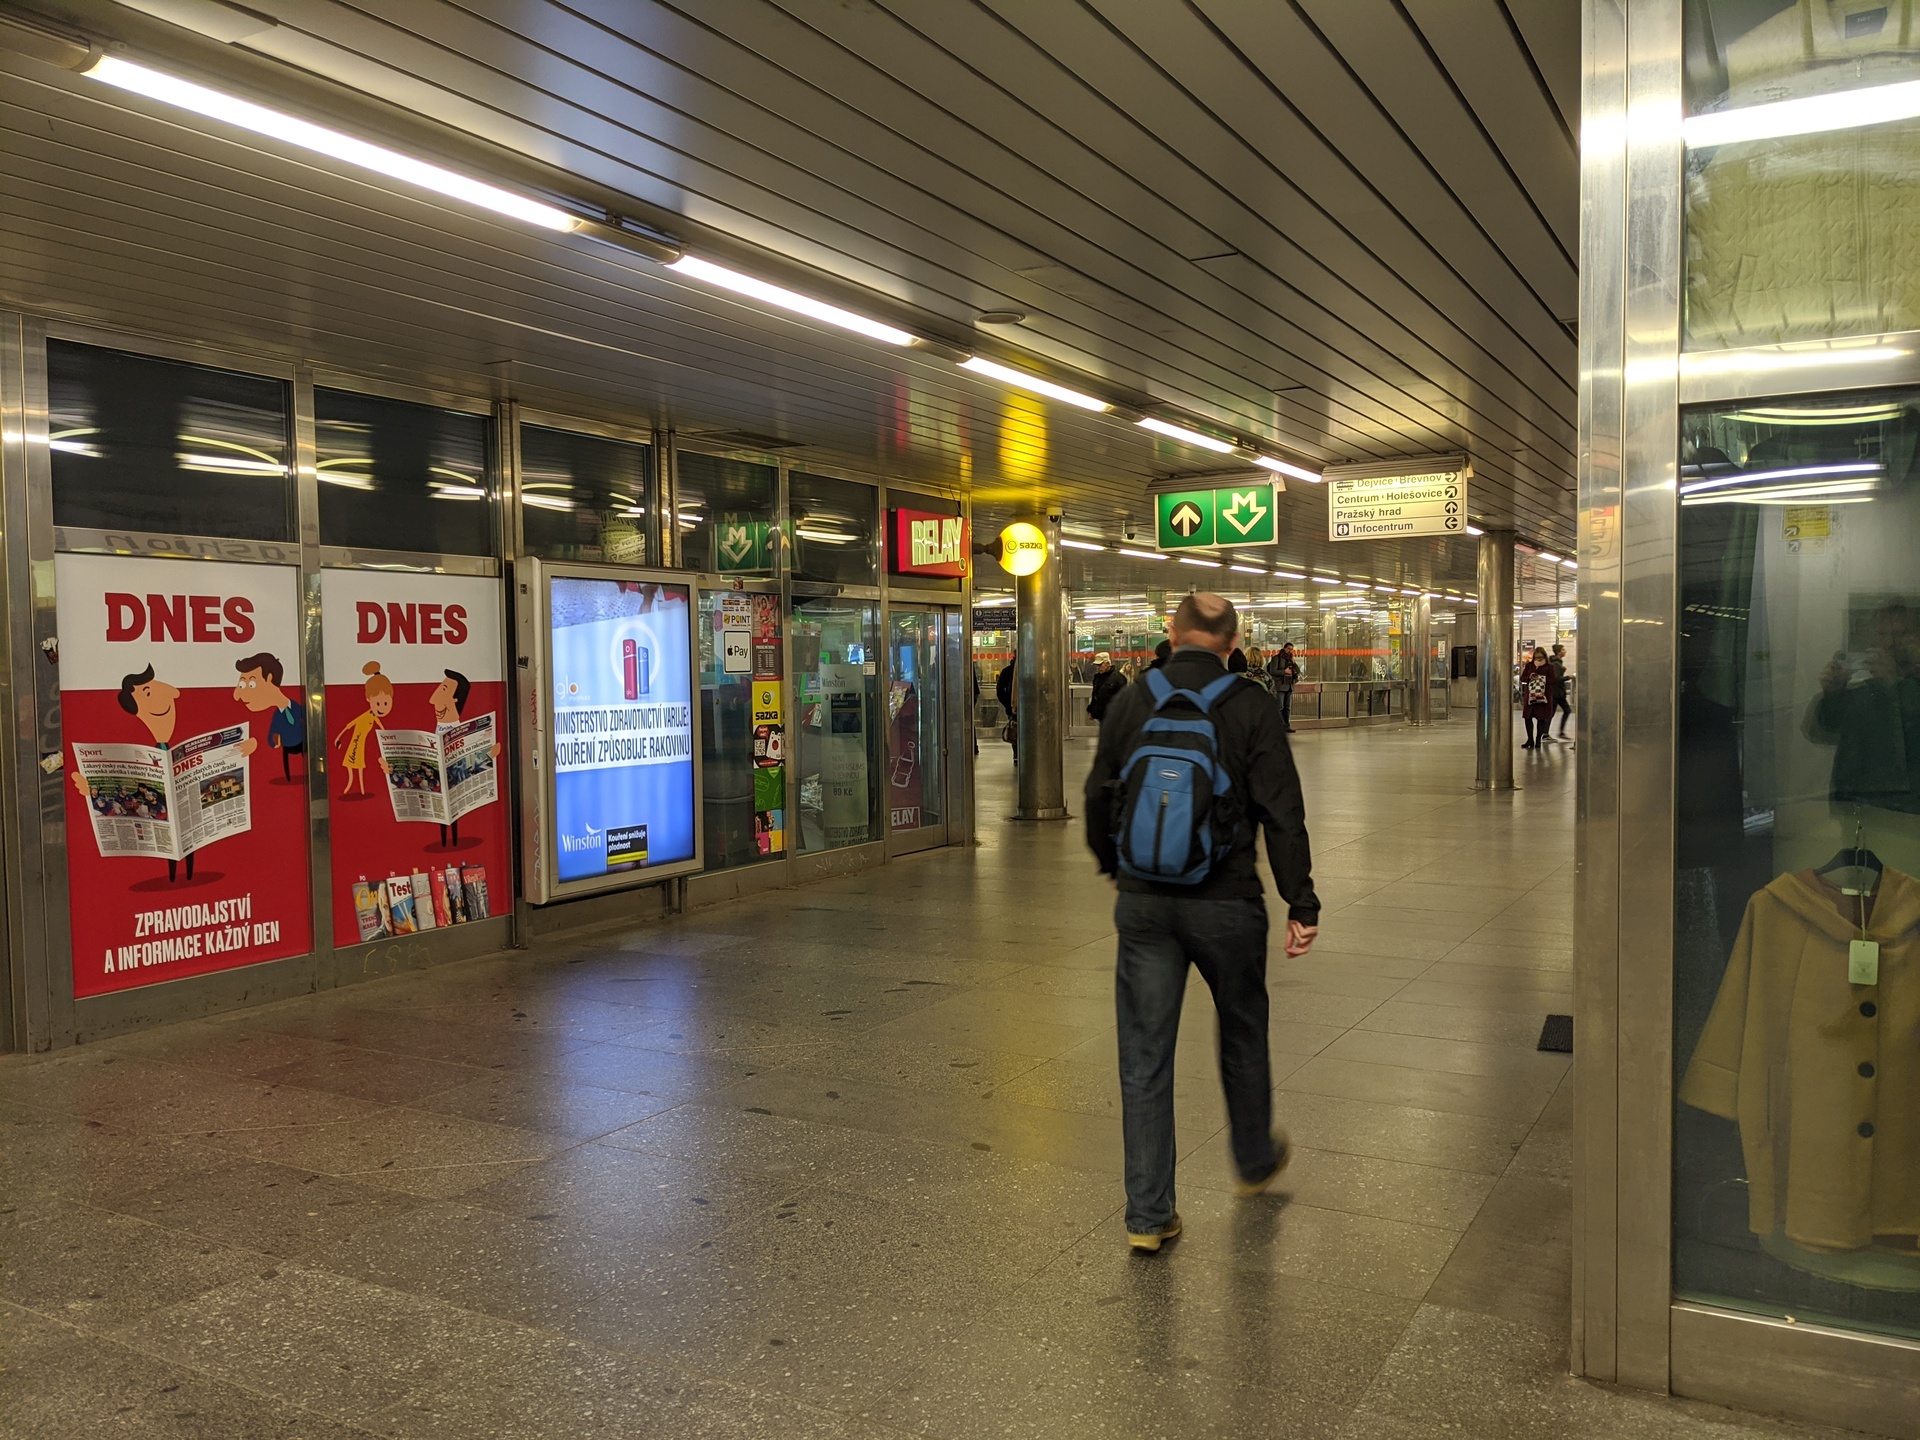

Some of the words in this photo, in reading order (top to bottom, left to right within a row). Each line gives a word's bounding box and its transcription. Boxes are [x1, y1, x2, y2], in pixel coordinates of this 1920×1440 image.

[1357, 478, 1393, 488] Dejvice
[1337, 494, 1379, 504] Centrum
[1386, 489, 1442, 500] Holešovice
[1337, 508, 1375, 519] Pražský
[1379, 507, 1401, 517] hrad
[1353, 522, 1413, 533] Infocentrum
[912, 517, 963, 566] RELAY
[105, 592, 255, 643] DNES
[356, 601, 468, 645] DNES
[734, 645, 748, 658] Pay
[556, 674, 578, 700] glo
[822, 678, 846, 688] Winston
[554, 709, 608, 735] MINISTERSTVO
[610, 703, 662, 732] ZDRAVOTNICTVÍ
[663, 706, 689, 728] VARUJE:
[755, 711, 778, 721] sazka
[79, 748, 102, 757] Sport
[444, 739, 465, 757] DNES
[555, 736, 596, 766] KOUŘENÍ
[598, 734, 647, 762] ZPŮSOBUJE
[649, 734, 690, 758] RAKOVINU
[173, 755, 203, 777] DNES
[174, 772, 193, 785] Konec
[833, 788, 842, 796] 89
[891, 807, 915, 827] ELAY
[562, 834, 602, 853] Winston
[608, 841, 631, 853] plodnost
[389, 882, 411, 897] Test
[135, 893, 251, 937] ZPRAVODAJSTVÍ
[104, 949, 115, 974] A
[118, 934, 202, 971] INFORMACE
[205, 922, 250, 955] KAŽDÝ
[253, 920, 280, 946] DEN
